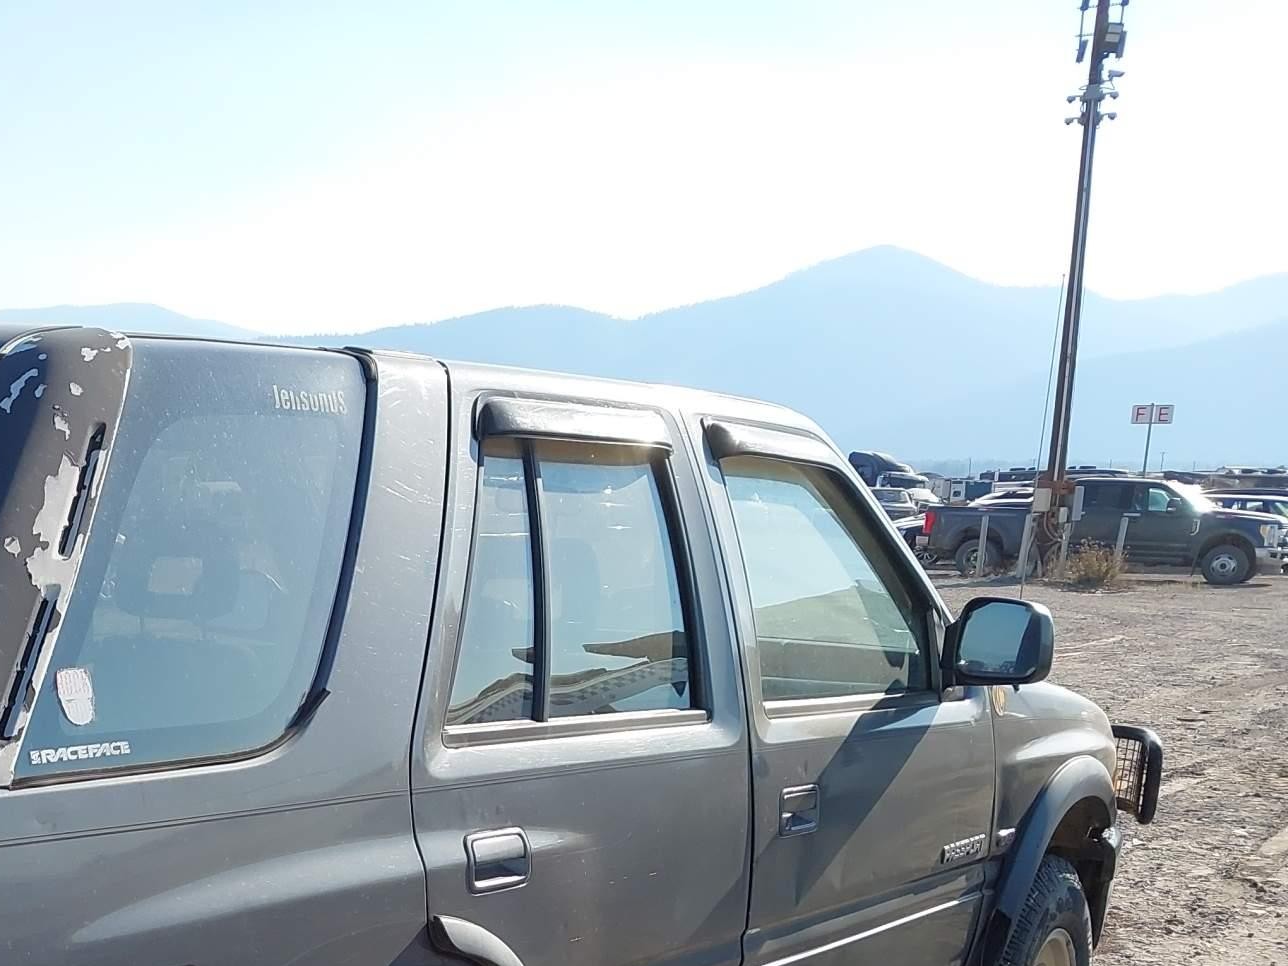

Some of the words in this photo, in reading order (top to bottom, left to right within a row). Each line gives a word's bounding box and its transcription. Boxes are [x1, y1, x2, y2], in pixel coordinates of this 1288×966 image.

[1135, 406, 1147, 422] F
[1158, 406, 1170, 422] E
[39, 741, 131, 765] RACEFACE
